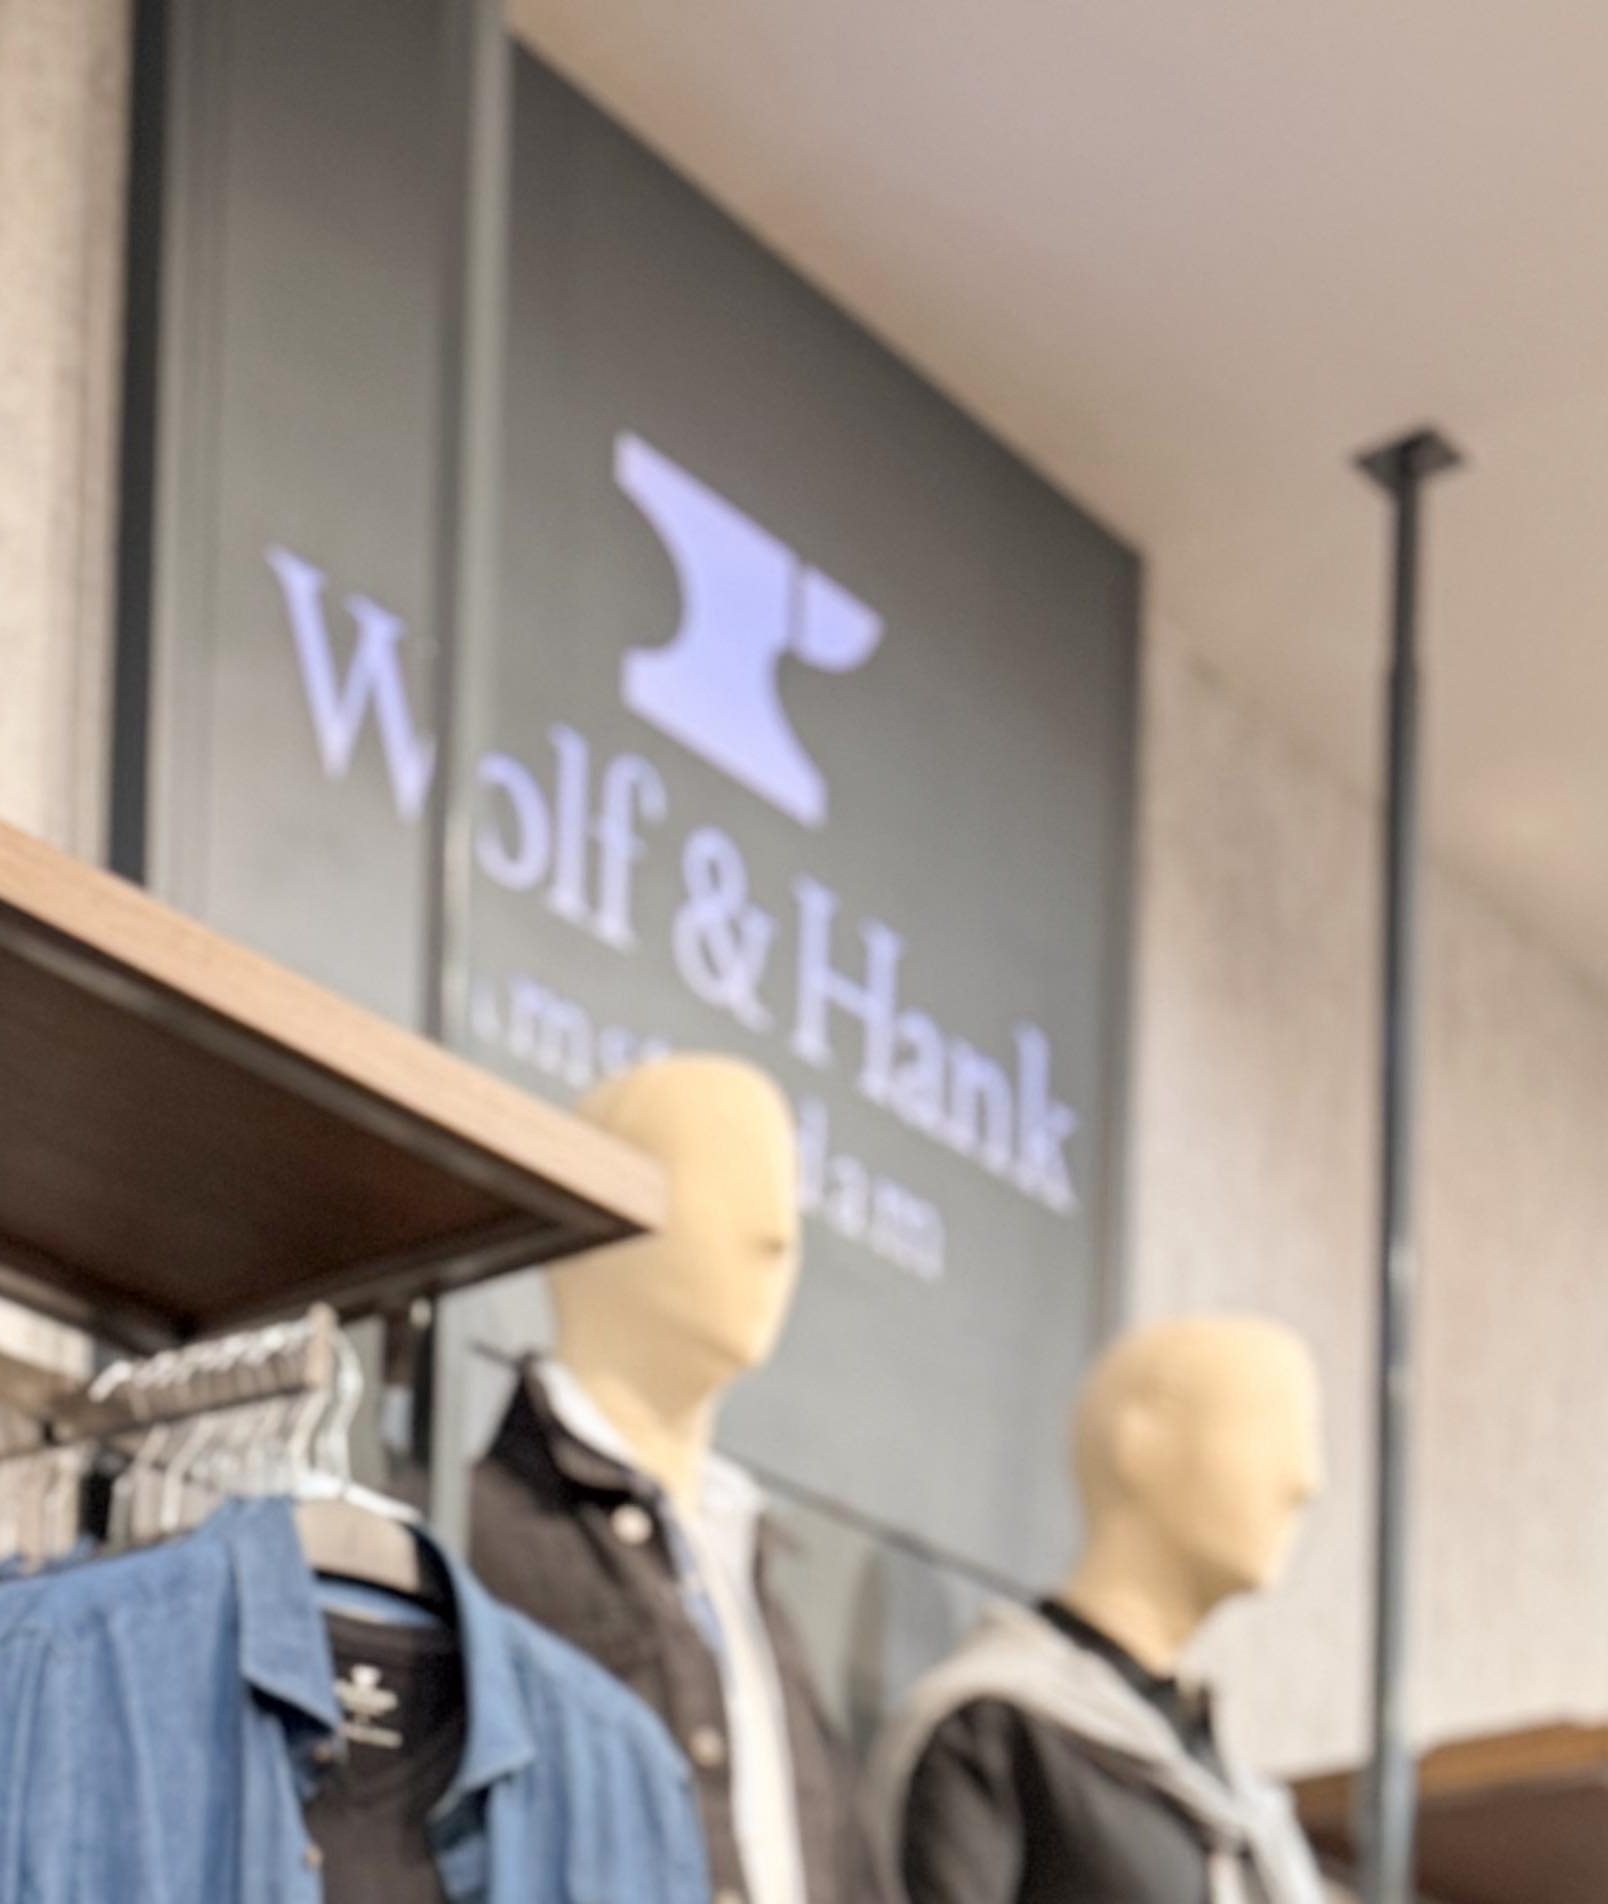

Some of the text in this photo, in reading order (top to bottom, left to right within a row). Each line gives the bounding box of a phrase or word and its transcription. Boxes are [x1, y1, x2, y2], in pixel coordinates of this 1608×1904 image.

[265, 543, 1078, 1212] Wolf & Hank
